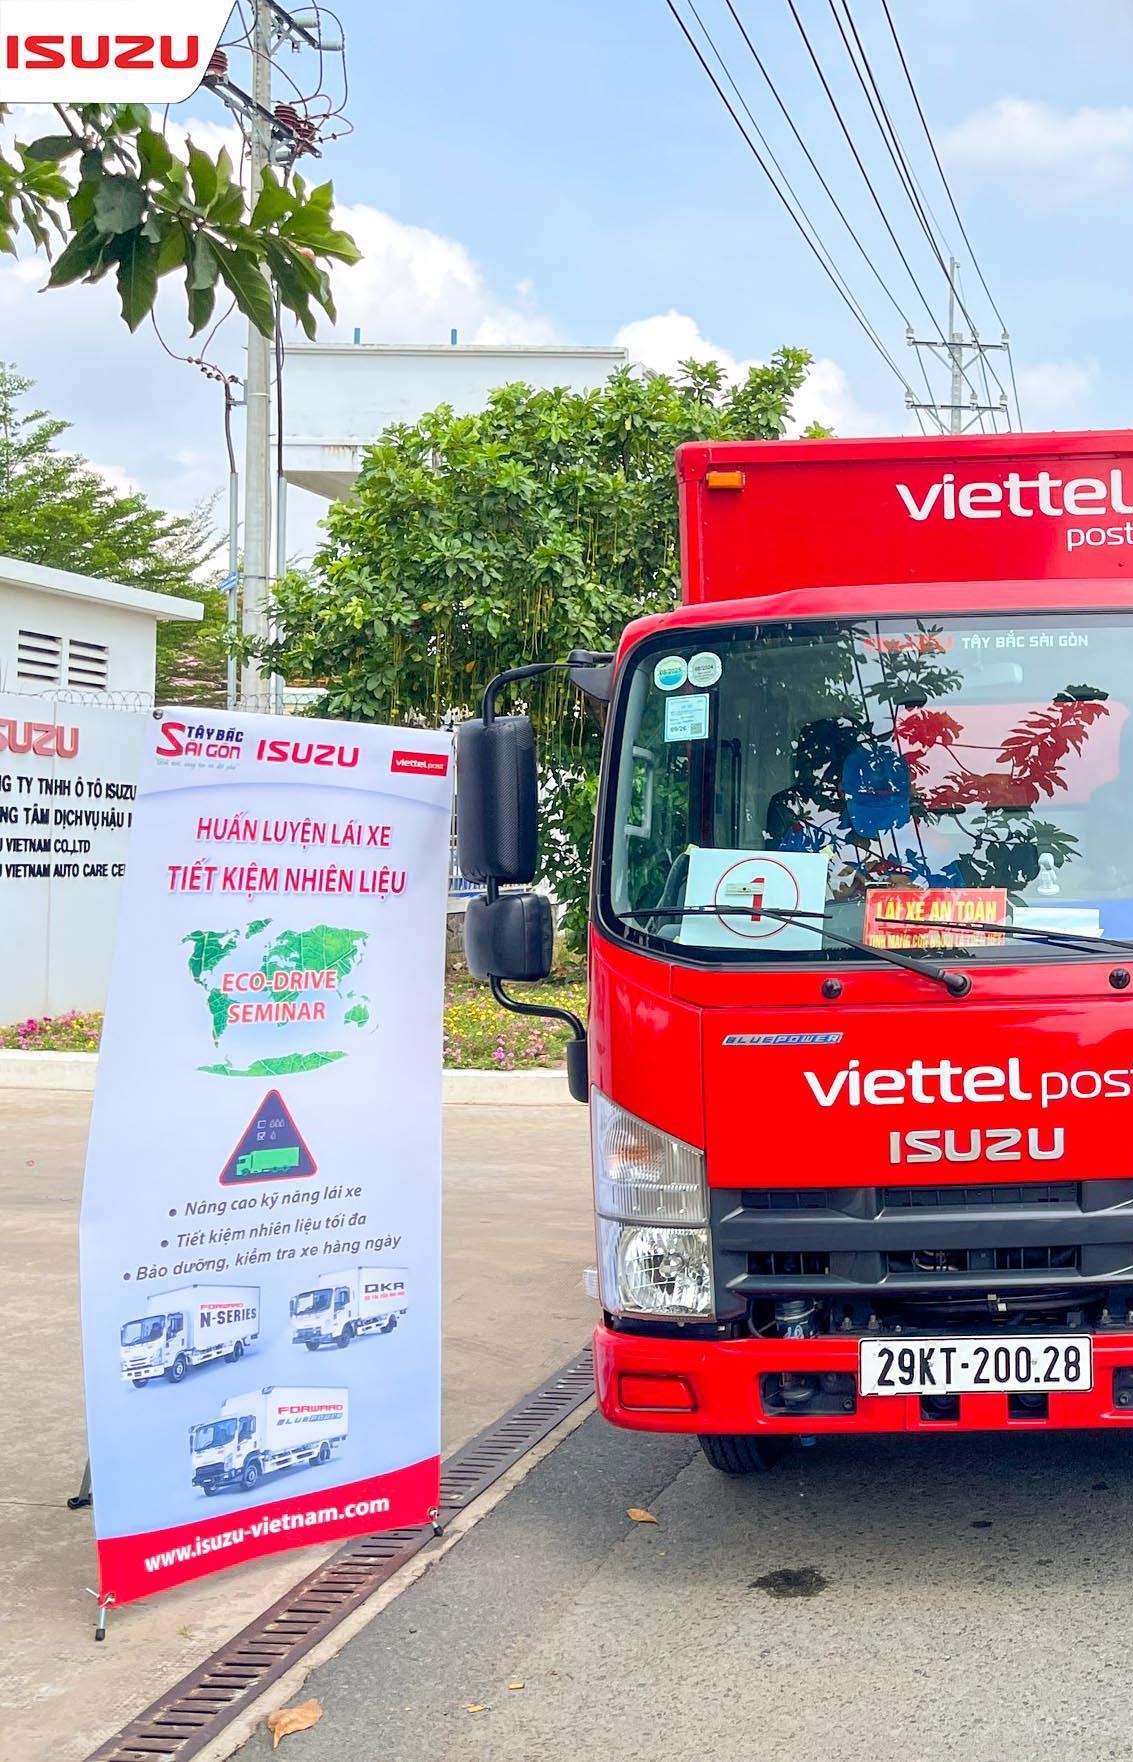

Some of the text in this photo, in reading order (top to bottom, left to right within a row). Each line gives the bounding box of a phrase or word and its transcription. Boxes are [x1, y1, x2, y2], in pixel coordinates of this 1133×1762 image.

[961, 635, 991, 649] TÂY
[996, 630, 1025, 648] BẮC
[1029, 633, 1053, 647] SÀI
[1058, 633, 1089, 647] GÒN
[187, 725, 244, 742] TÂY BẮC
[257, 739, 359, 768] ISUZU
[396, 759, 427, 768] viettel
[17, 776, 33, 794] TY
[38, 778, 71, 796] TNHH
[75, 776, 84, 797] Ô
[87, 778, 102, 798] TÔ
[105, 783, 137, 800] ISUZU
[24, 803, 49, 824] TÂM
[55, 809, 82, 829] DỊCH
[84, 810, 99, 830] VỤ
[102, 807, 124, 831] HẬU
[197, 811, 391, 849] HUẤN LUYỆN LÁI XE
[6, 838, 51, 852] VIETNAM
[5, 864, 50, 877] VIETNAM
[53, 864, 79, 877] AUTO
[83, 864, 108, 877] CARE
[111, 864, 125, 877] CE
[168, 858, 406, 900] TIẾT KIỆM NHIÊN LIỆU
[751, 878, 765, 921] 1
[876, 896, 997, 922] LÁI XE AN TOÀN
[222, 970, 338, 993] ECO-DRIVE
[227, 1001, 326, 1024] SEMINAR
[725, 1033, 840, 1044] BLUEPOWER
[804, 1057, 1032, 1107] viettel
[890, 1127, 1064, 1164] ISUZU
[184, 1185, 362, 1217] Nâng cao kỹ năng lái xe
[176, 1212, 366, 1248] Tiết kiệm nhiên liệu tối đa
[136, 1233, 402, 1281] Bảo dưỡng, kiểm tra xe hàng ngày
[365, 1282, 404, 1293] QKR
[200, 1308, 257, 1328] N-SERIES
[877, 1344, 1081, 1388] 29KT-200.28
[278, 1404, 343, 1415] FORWARD
[144, 1497, 390, 1572] www.isuzu-vietnam.com
